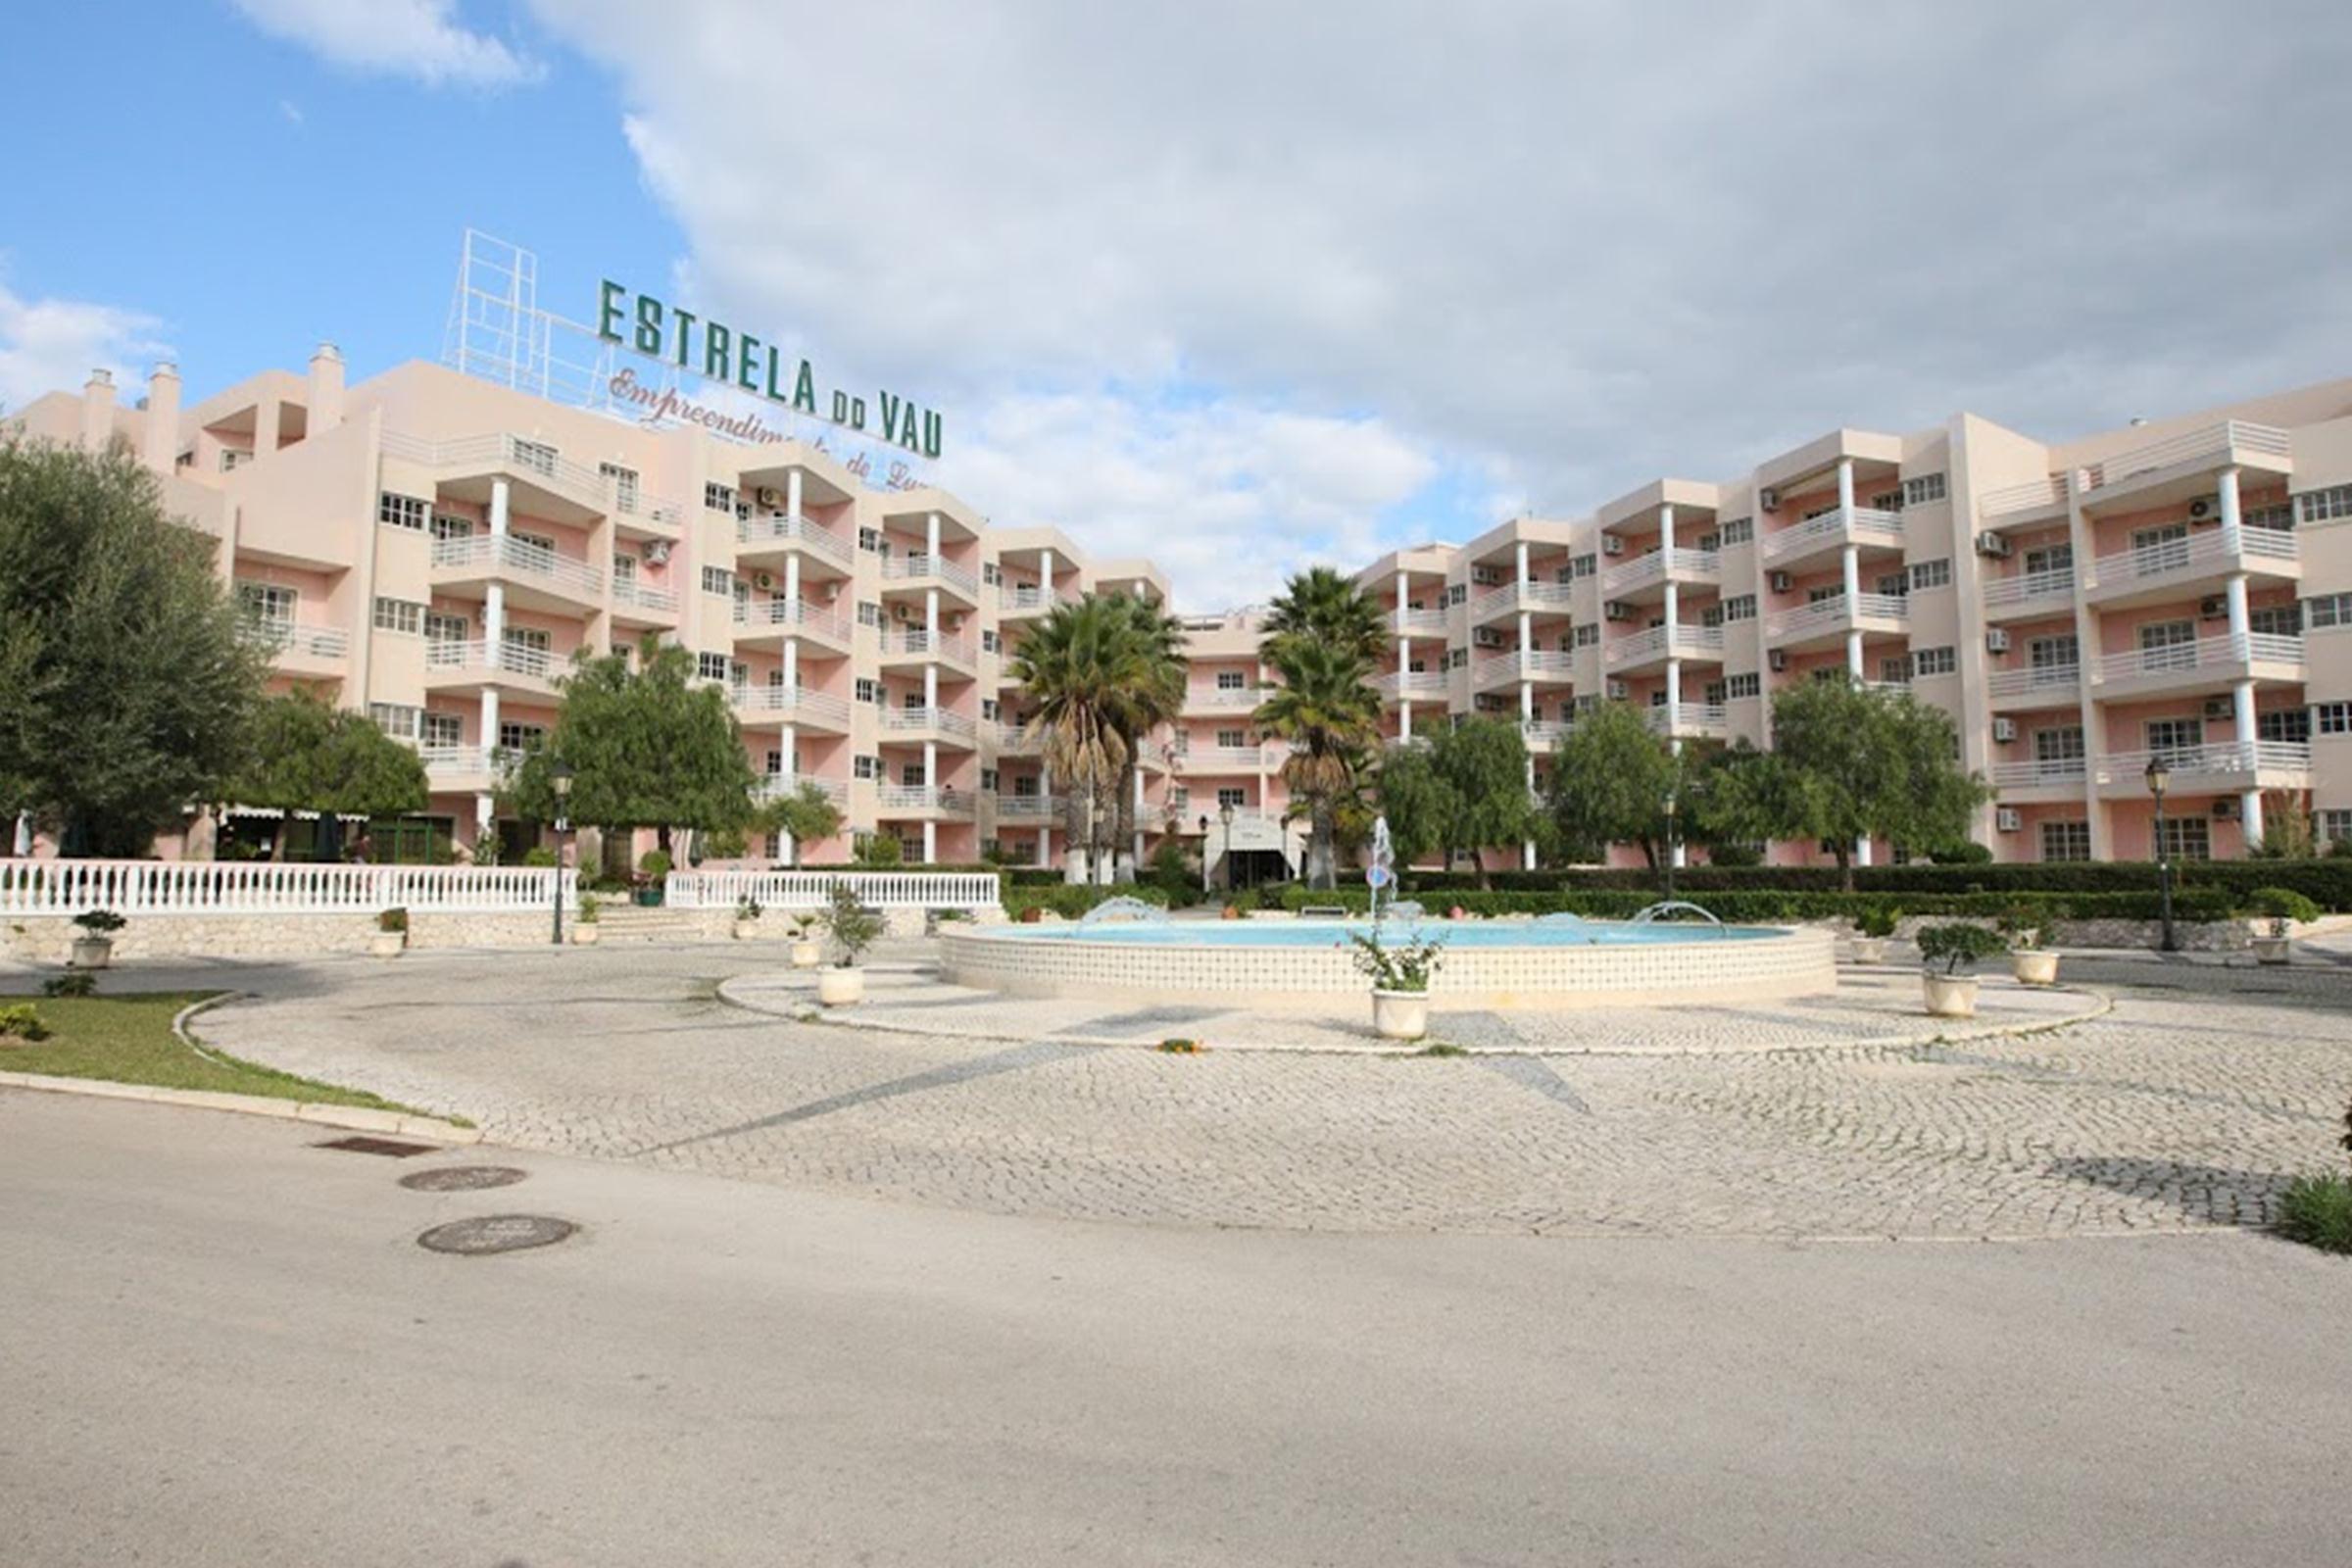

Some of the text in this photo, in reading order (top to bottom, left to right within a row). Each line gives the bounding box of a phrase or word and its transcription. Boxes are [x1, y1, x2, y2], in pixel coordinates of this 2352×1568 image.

[599, 278, 942, 459] ESTRELA DO VAU
[847, 452, 870, 477] de
